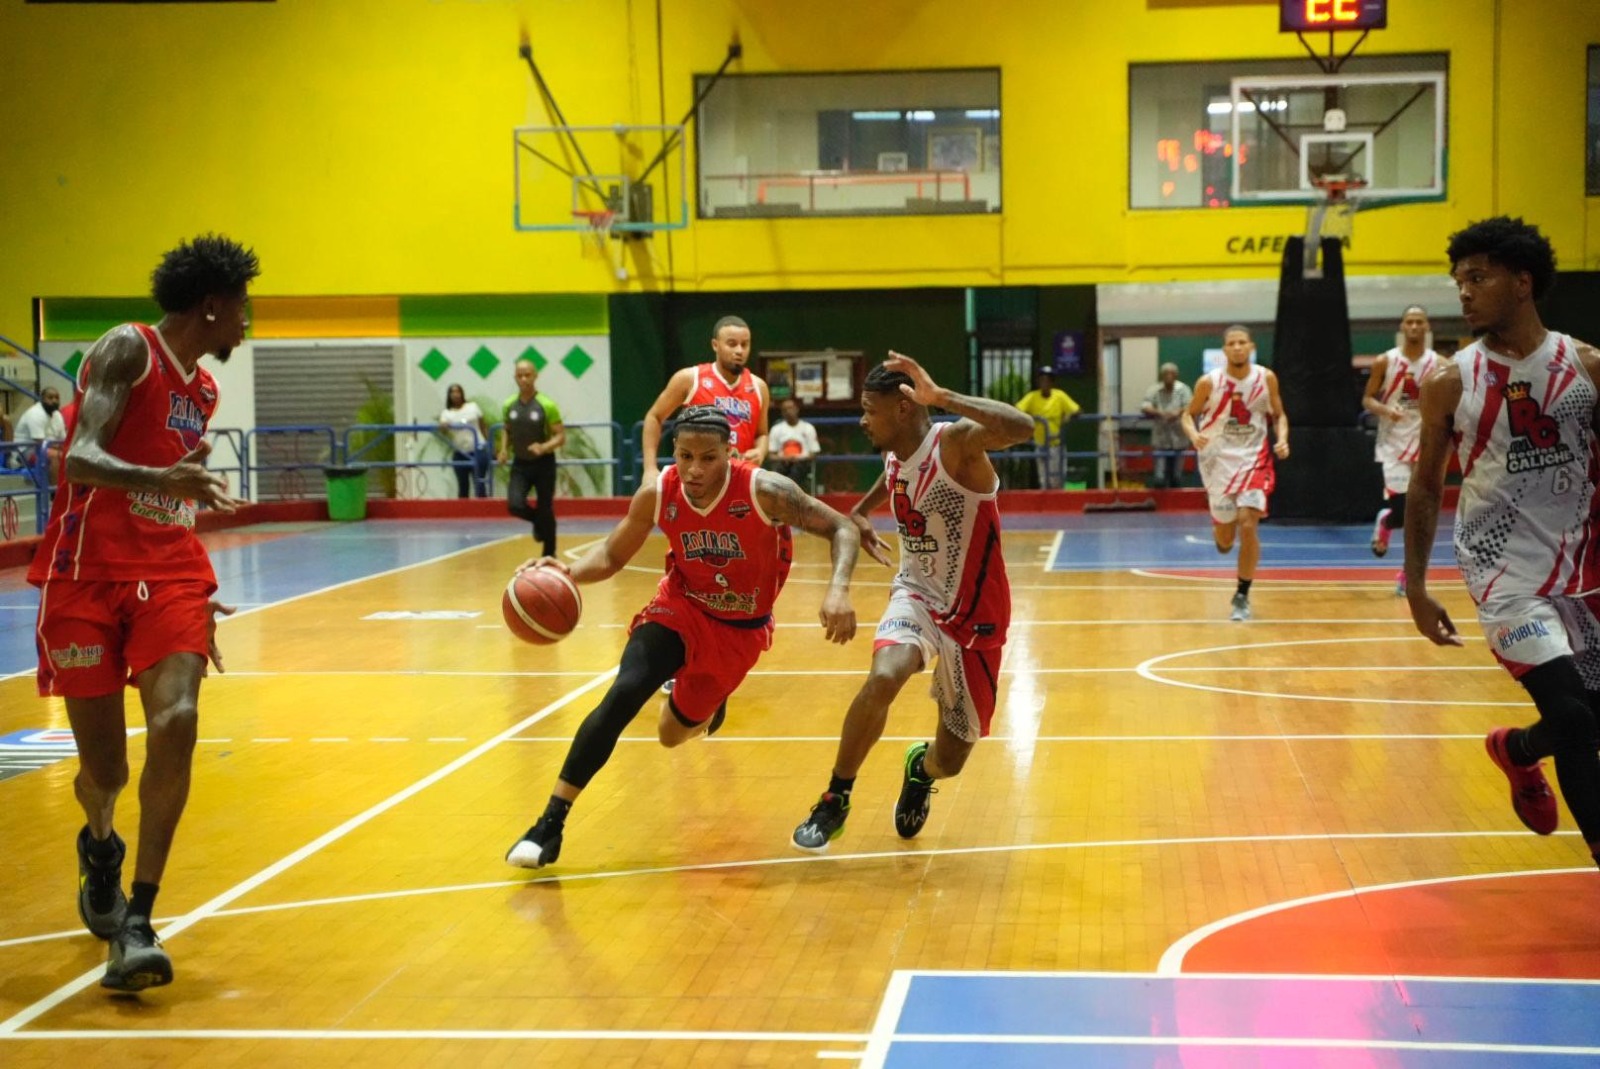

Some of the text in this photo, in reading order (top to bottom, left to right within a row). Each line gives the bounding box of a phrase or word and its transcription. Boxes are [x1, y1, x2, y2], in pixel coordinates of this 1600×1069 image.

[1226, 235, 1352, 254] CAFEA
[1552, 466, 1572, 495] 6
[681, 530, 741, 551] POTROS
[919, 552, 936, 577] 3
